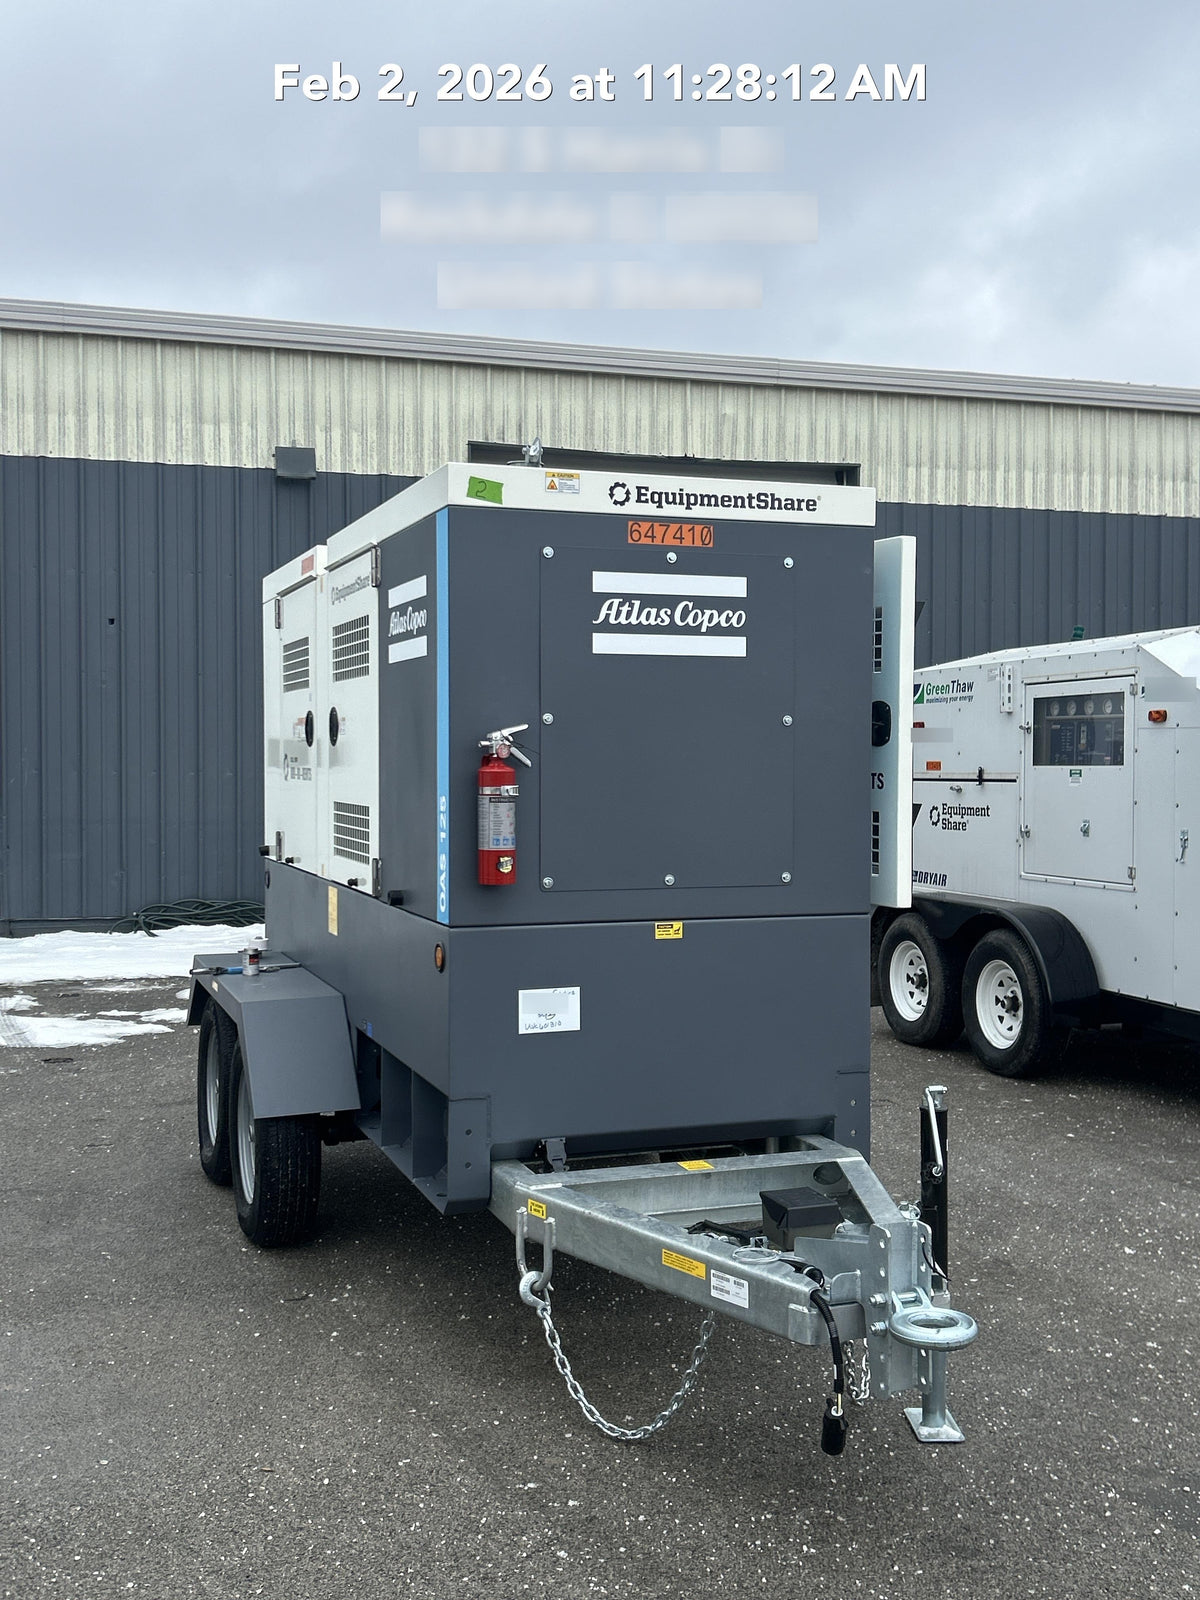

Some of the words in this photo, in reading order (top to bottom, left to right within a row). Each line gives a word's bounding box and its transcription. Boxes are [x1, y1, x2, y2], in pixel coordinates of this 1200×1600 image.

[475, 480, 488, 498] 2
[634, 486, 818, 512] EquipmentShare
[629, 522, 712, 546] 647410
[593, 598, 672, 627] Atlas
[674, 601, 747, 632] Copco
[871, 772, 885, 790] TS
[439, 795, 447, 843] 125
[942, 803, 991, 819] Equipment
[941, 817, 967, 832] Share
[918, 870, 948, 887] DRYAIR
